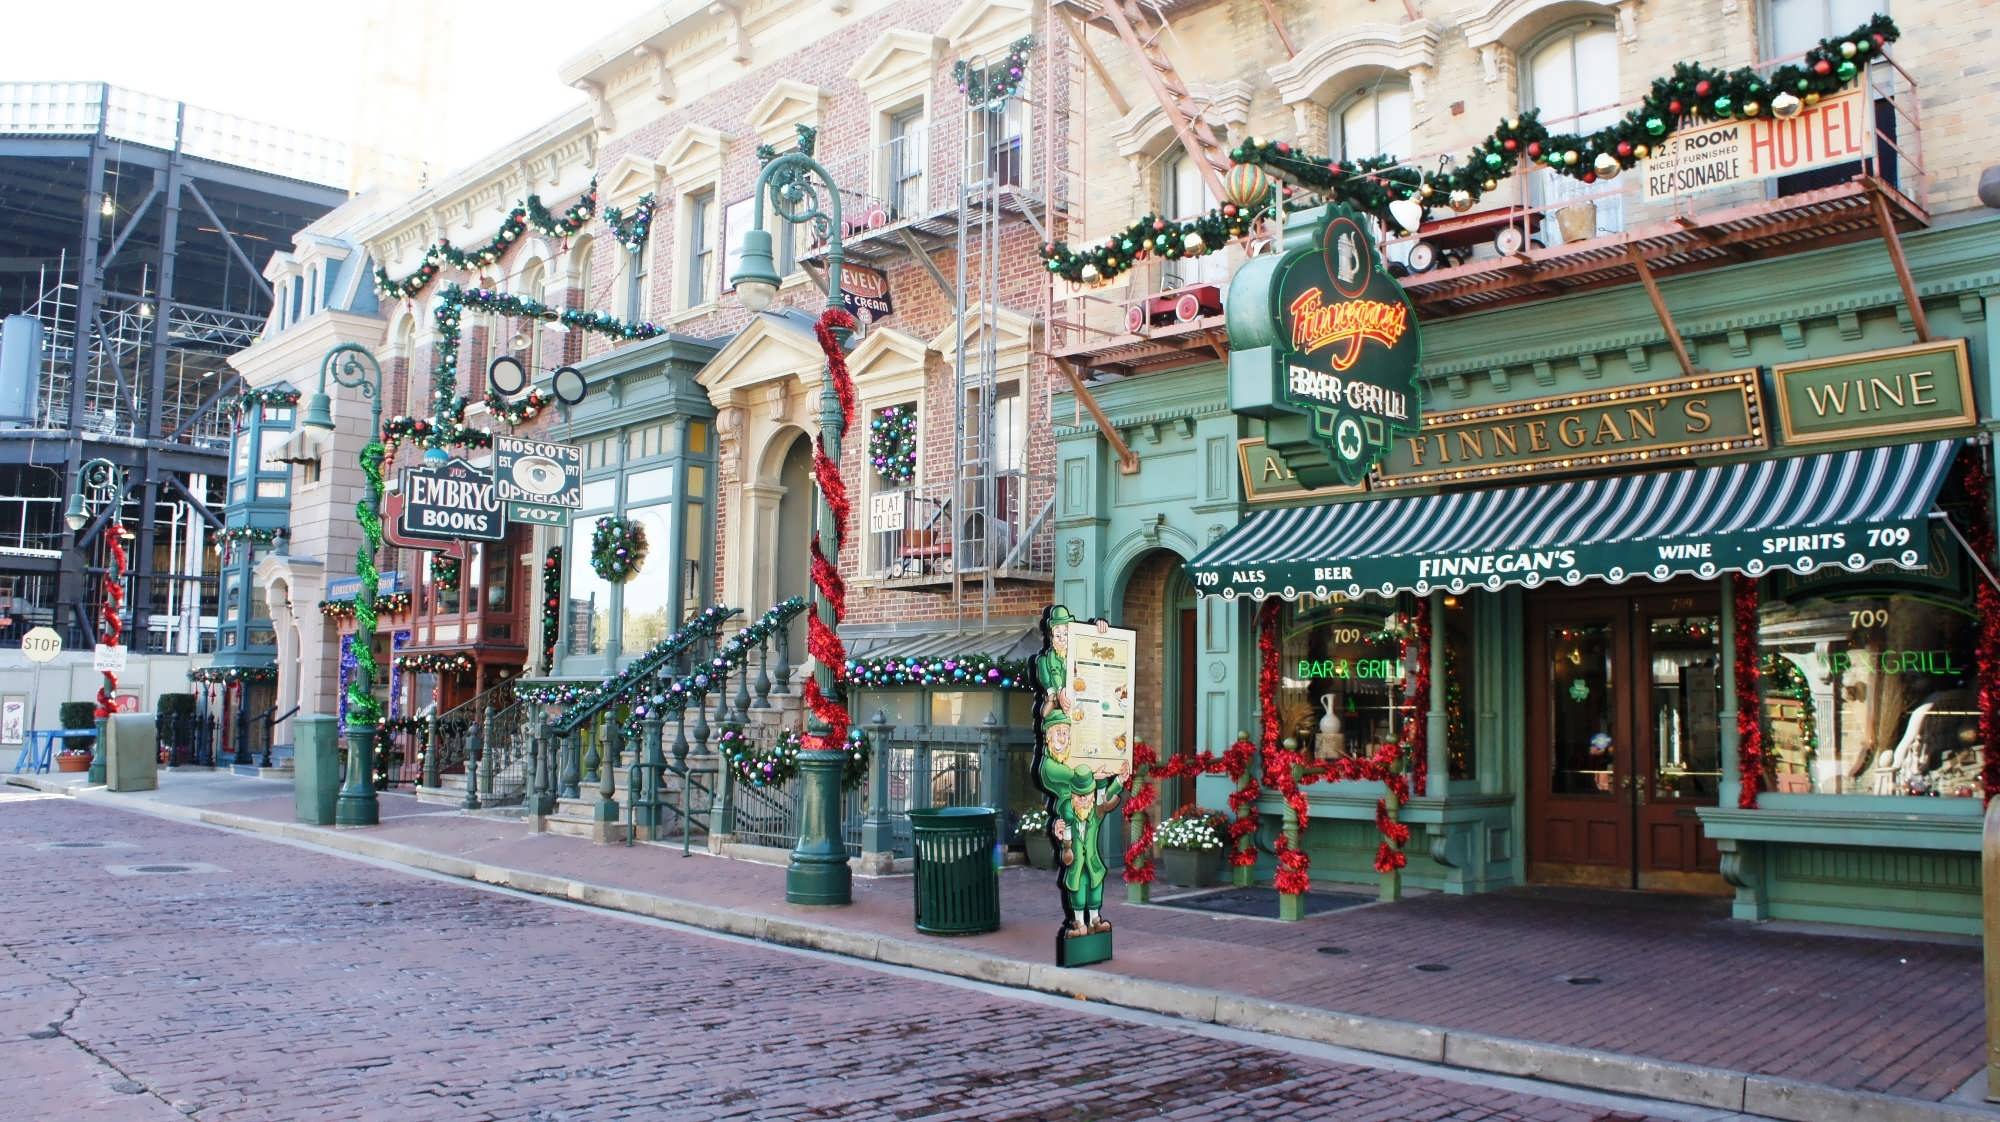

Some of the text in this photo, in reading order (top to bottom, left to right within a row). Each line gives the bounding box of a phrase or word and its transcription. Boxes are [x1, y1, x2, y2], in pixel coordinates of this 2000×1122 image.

[1685, 128, 1738, 151] ROOM
[1750, 101, 1861, 174] HOTEL
[1683, 145, 1738, 164] FURNISHED
[1650, 158, 1739, 196] REASONABLE
[840, 268, 883, 298] EVELY
[854, 296, 888, 313] CREAM
[1806, 371, 1937, 417] WINE
[1408, 399, 1712, 466] FINNEGAN'S
[498, 439, 579, 461] MOSCOT'S
[565, 465, 579, 476] 1917
[498, 480, 579, 506] OPTICIANS
[517, 507, 561, 522] 707
[875, 496, 899, 513] FLAT
[423, 510, 488, 532] BOOKS
[873, 513, 902, 530] TO LET
[1195, 527, 1911, 587] 709 ALES BEER FINNEGAN'S WINE SPIRITS 709
[1850, 609, 1889, 629] 709
[23, 637, 60, 652] STOP
[1334, 628, 1360, 644] 709
[1298, 659, 1405, 679] BAR & GRILL
[1881, 650, 1962, 675] GRILL
